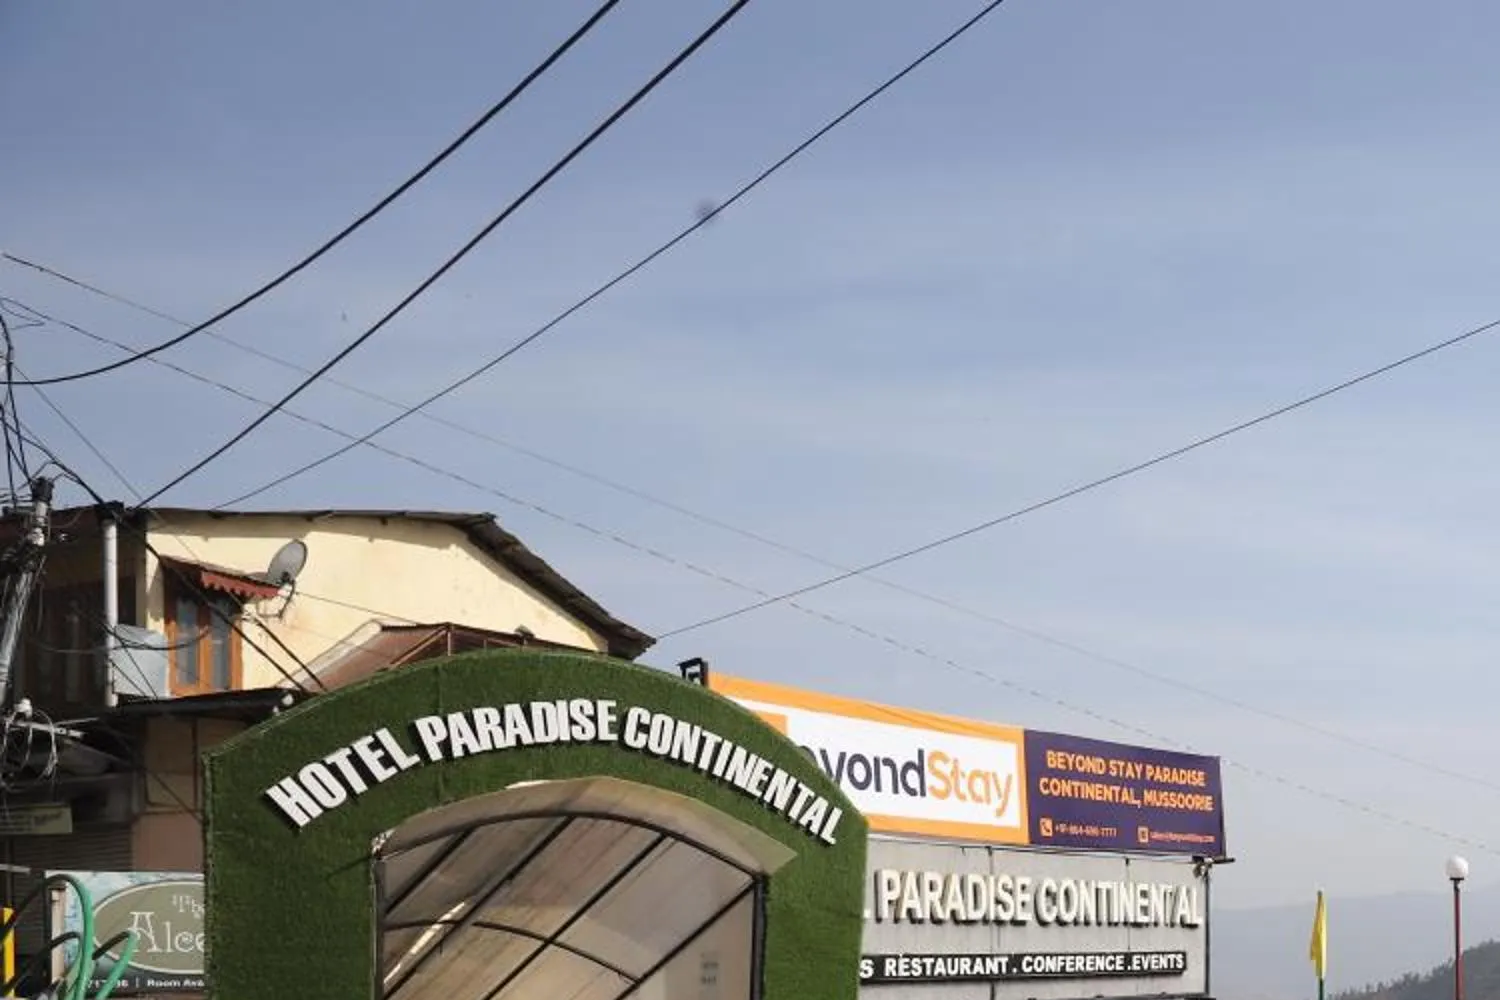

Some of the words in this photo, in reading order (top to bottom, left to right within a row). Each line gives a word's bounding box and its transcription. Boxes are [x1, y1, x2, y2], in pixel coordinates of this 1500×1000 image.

[265, 727, 421, 827] HOTEL
[414, 699, 618, 762] PARADISE
[623, 706, 843, 845] CONTINENTAL
[799, 746, 1012, 818] yondStay
[1046, 750, 1105, 775] BEYOND
[1109, 759, 1143, 779] STAY
[1145, 766, 1206, 787] PARADISE
[1039, 777, 1141, 808] CONTINENTAL,
[1143, 789, 1214, 811] MUSSOORIE
[876, 869, 1034, 923] PARADISE
[1036, 878, 1203, 926] CONTINENTAL
[884, 956, 1009, 979] RESTAURANT
[1022, 955, 1126, 975] CONFERENCE
